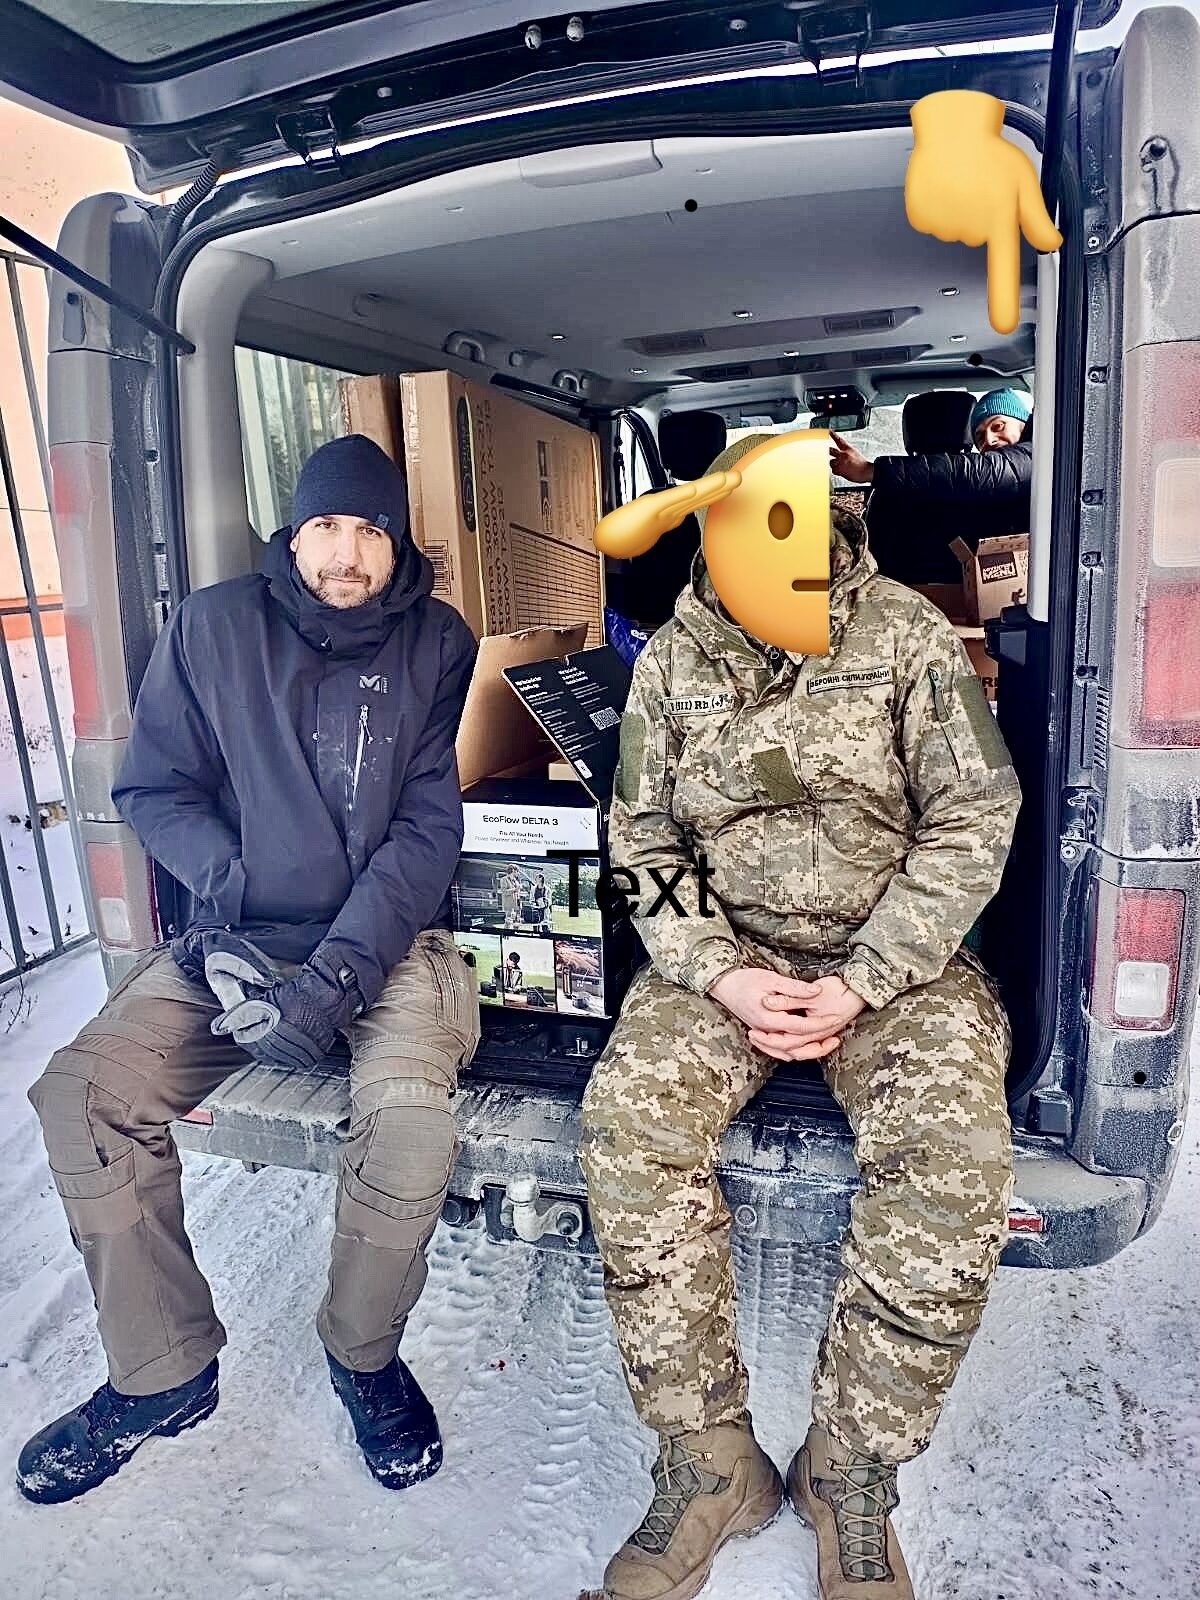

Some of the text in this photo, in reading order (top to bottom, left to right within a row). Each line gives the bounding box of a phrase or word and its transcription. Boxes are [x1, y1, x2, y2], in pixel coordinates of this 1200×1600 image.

[483, 814, 559, 826] EcoFlow DELTA 3
